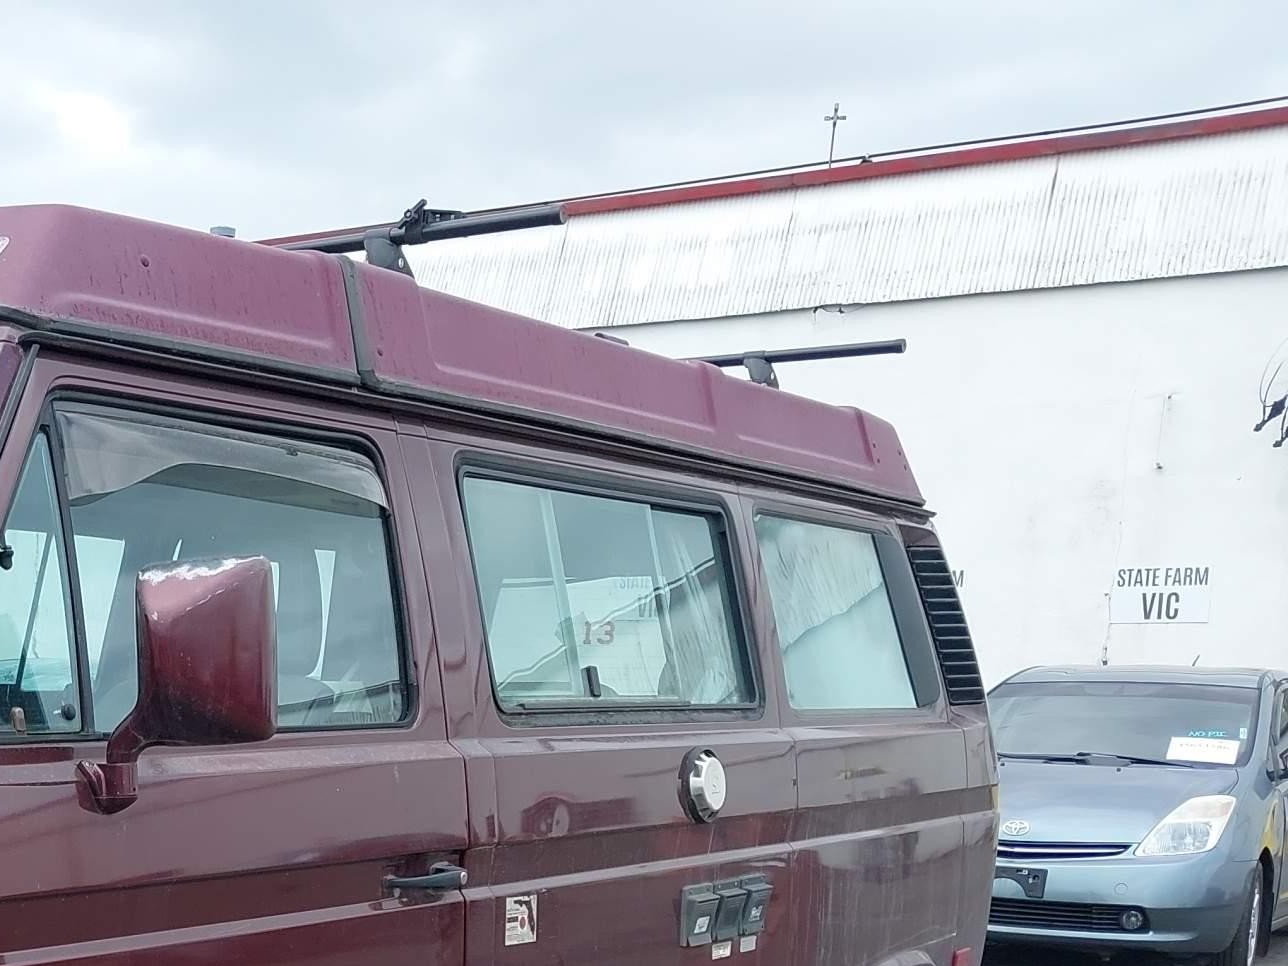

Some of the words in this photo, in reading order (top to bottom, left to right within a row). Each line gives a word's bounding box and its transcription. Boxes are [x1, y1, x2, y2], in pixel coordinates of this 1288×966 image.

[1116, 568, 1161, 587] STATE
[1164, 566, 1210, 586] FARM
[1142, 591, 1180, 620] VIC
[583, 620, 616, 645] 13
